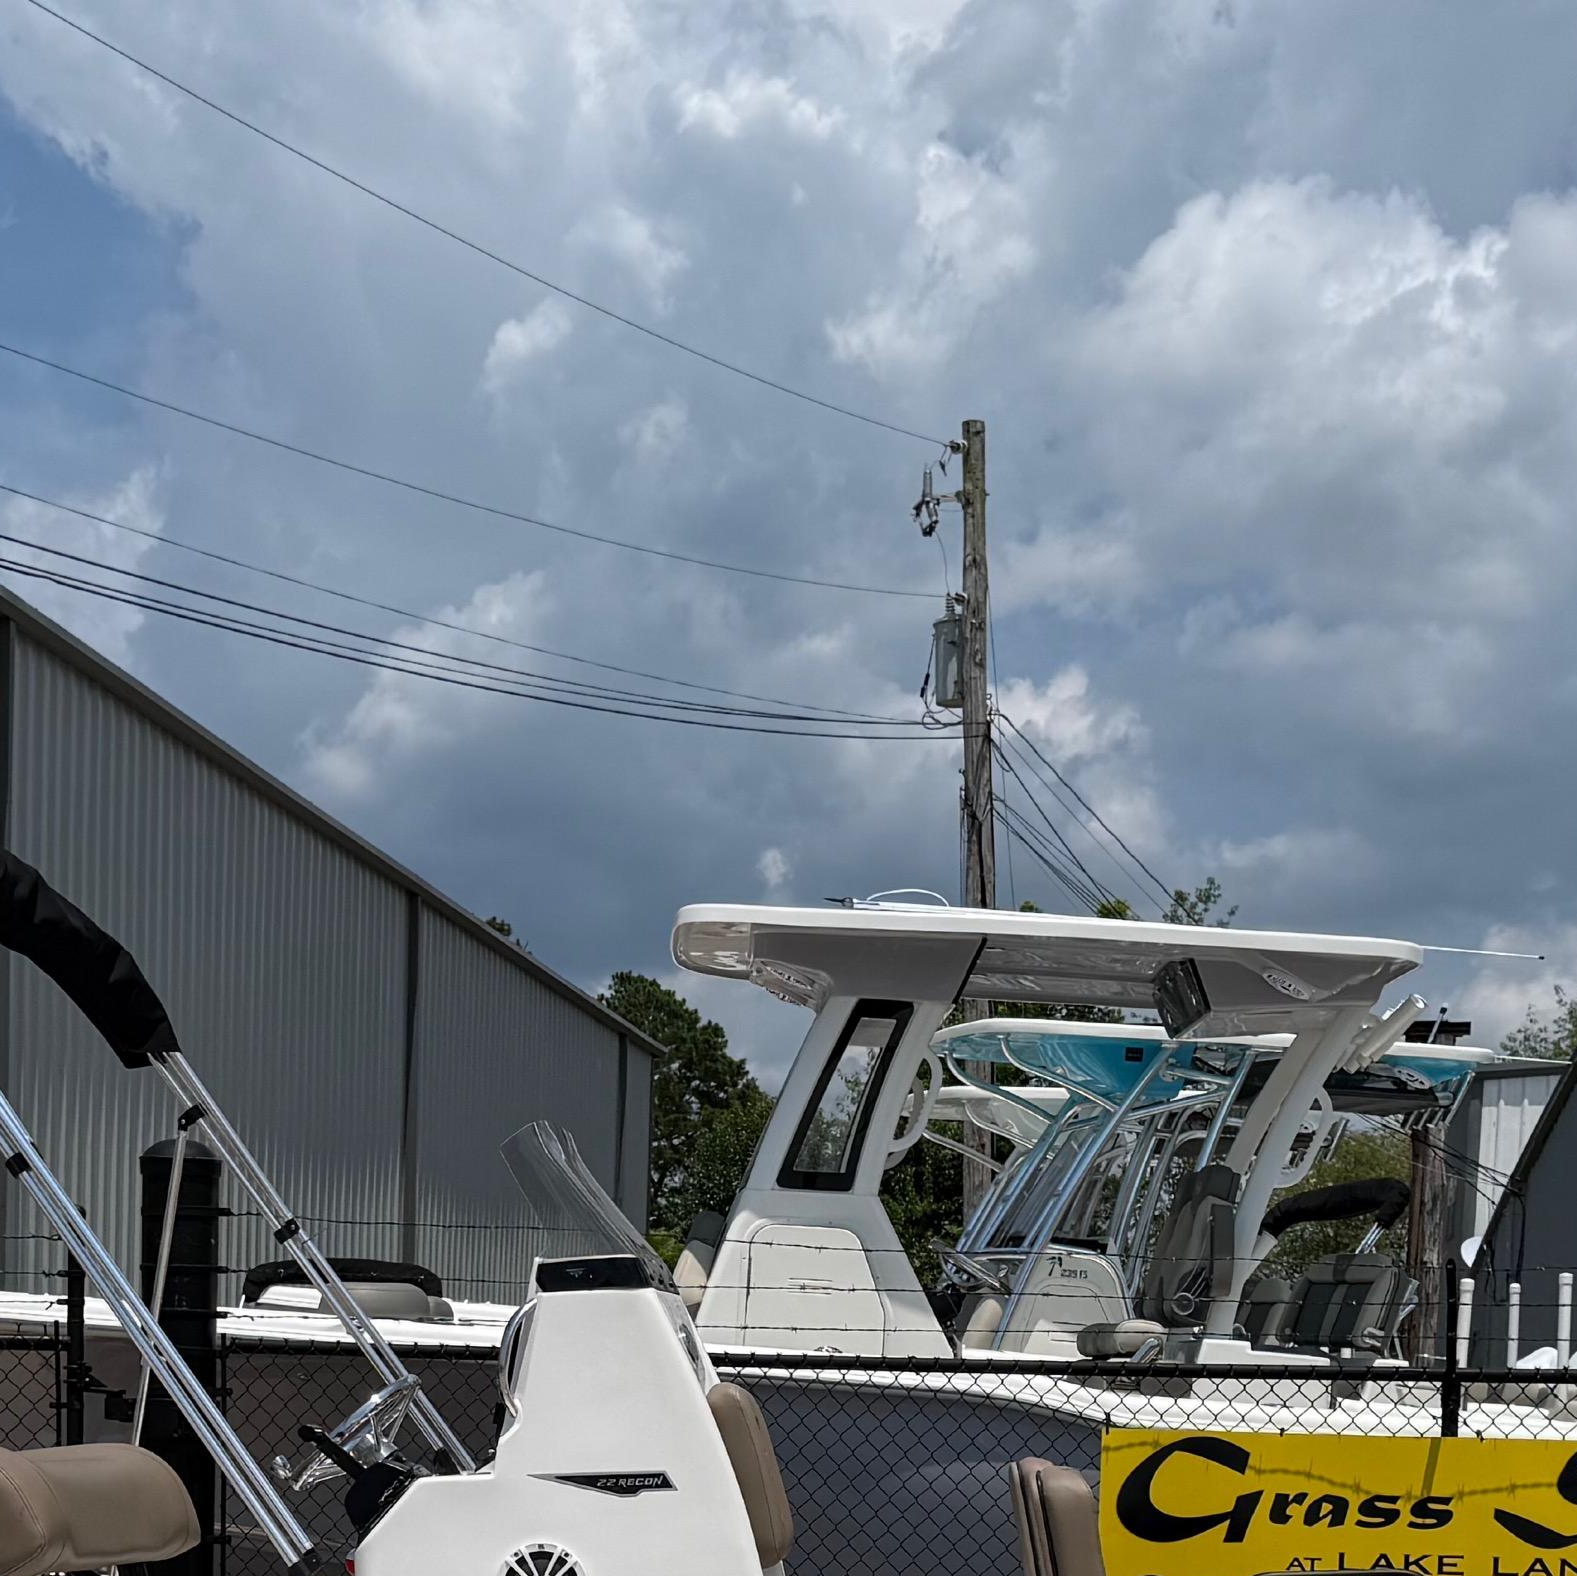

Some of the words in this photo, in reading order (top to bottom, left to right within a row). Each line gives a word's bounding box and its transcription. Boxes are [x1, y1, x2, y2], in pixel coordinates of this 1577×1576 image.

[597, 1478, 616, 1487] 22
[617, 1475, 664, 1488] RECON
[1116, 1436, 1455, 1544] Grass
[1285, 1556, 1322, 1571] AT
[1338, 1551, 1465, 1576] LAKE
